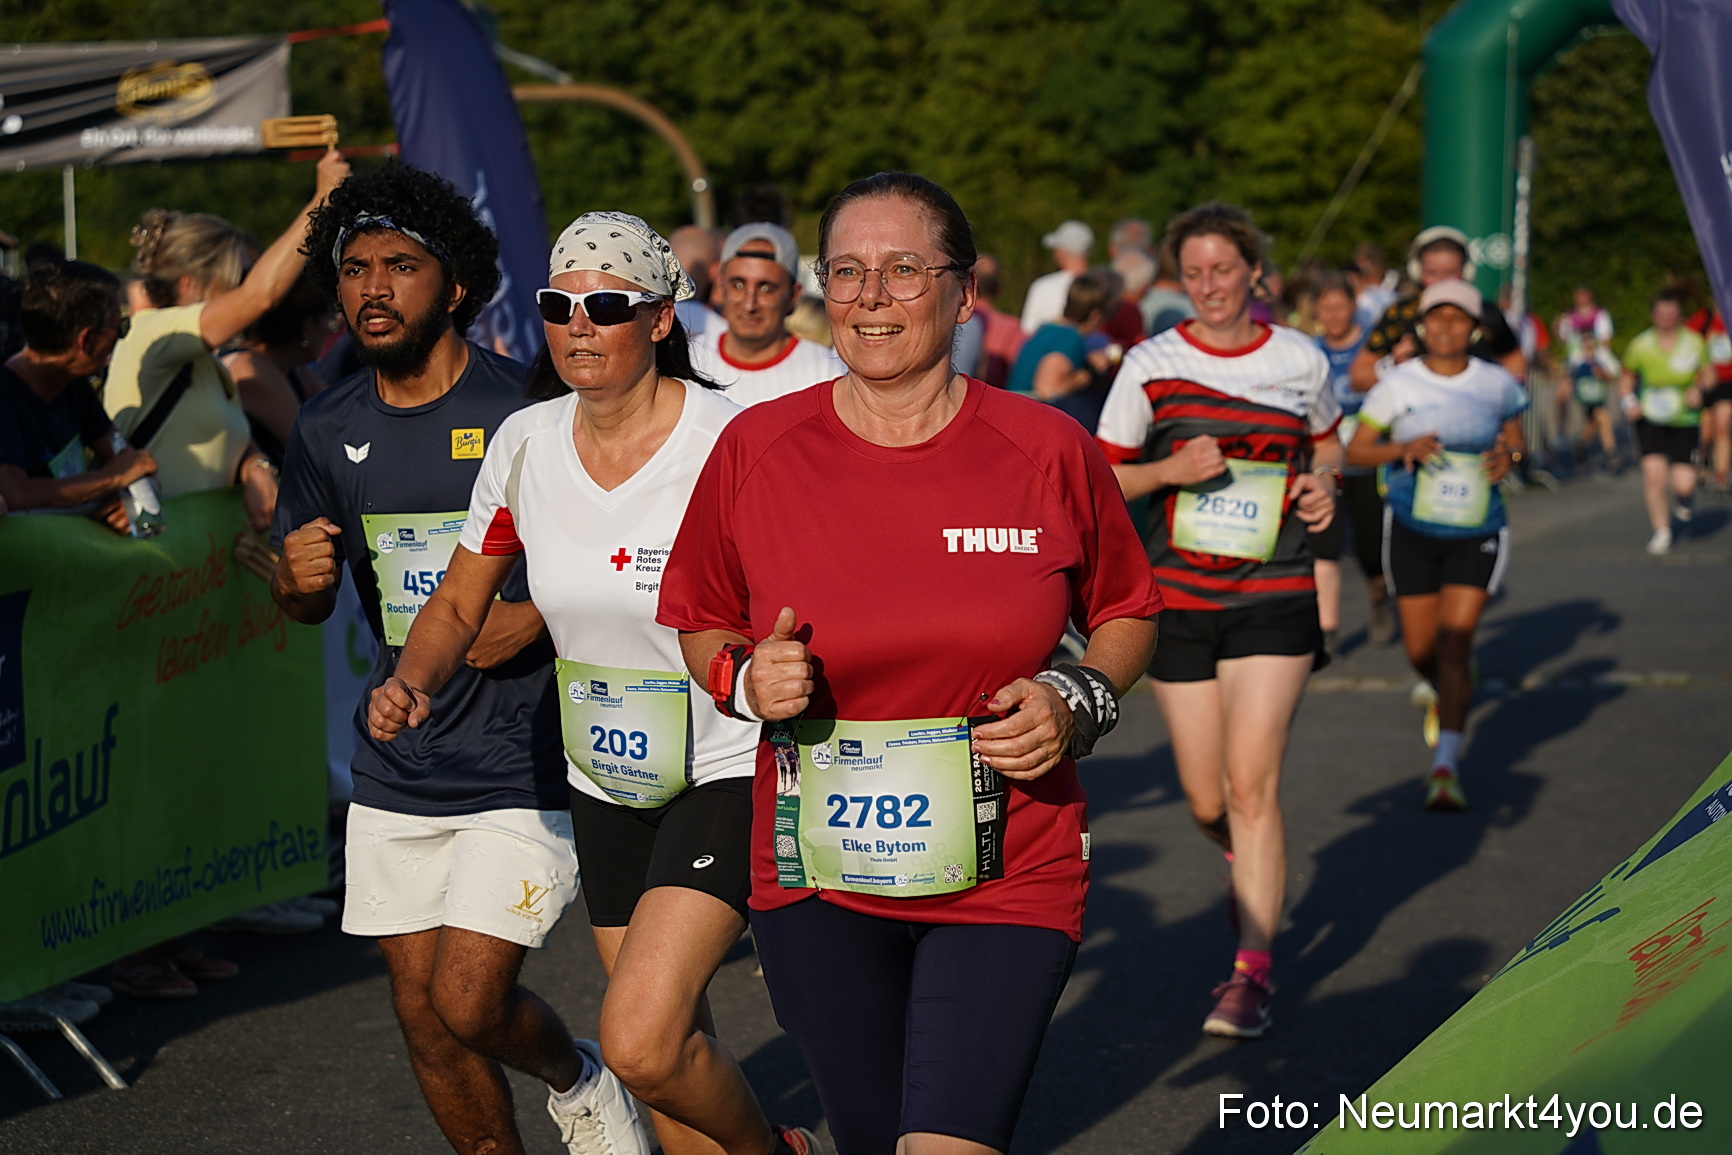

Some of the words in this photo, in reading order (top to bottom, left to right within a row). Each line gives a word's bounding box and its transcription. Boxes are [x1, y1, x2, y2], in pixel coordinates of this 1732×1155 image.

[1195, 493, 1258, 519] 2620
[396, 540, 428, 549] Firmenlauf
[636, 556, 662, 564] Rotes
[635, 564, 661, 572] Kreuz
[635, 581, 659, 593] Birgit
[386, 602, 416, 614] Rochel
[586, 693, 624, 704] Firmenlauf
[590, 725, 648, 761] 203
[833, 755, 884, 766] Firmenlauf
[591, 758, 619, 775] Birgit
[620, 764, 659, 781] Gärtner
[851, 764, 883, 772] neumarkt
[974, 769, 981, 778] %
[974, 778, 982, 793] 20
[826, 793, 932, 829] 2782
[842, 838, 871, 853] Elke
[876, 839, 927, 856] Bytom
[982, 825, 991, 872] HILTL
[844, 875, 893, 885] firmenlauf.bayern
